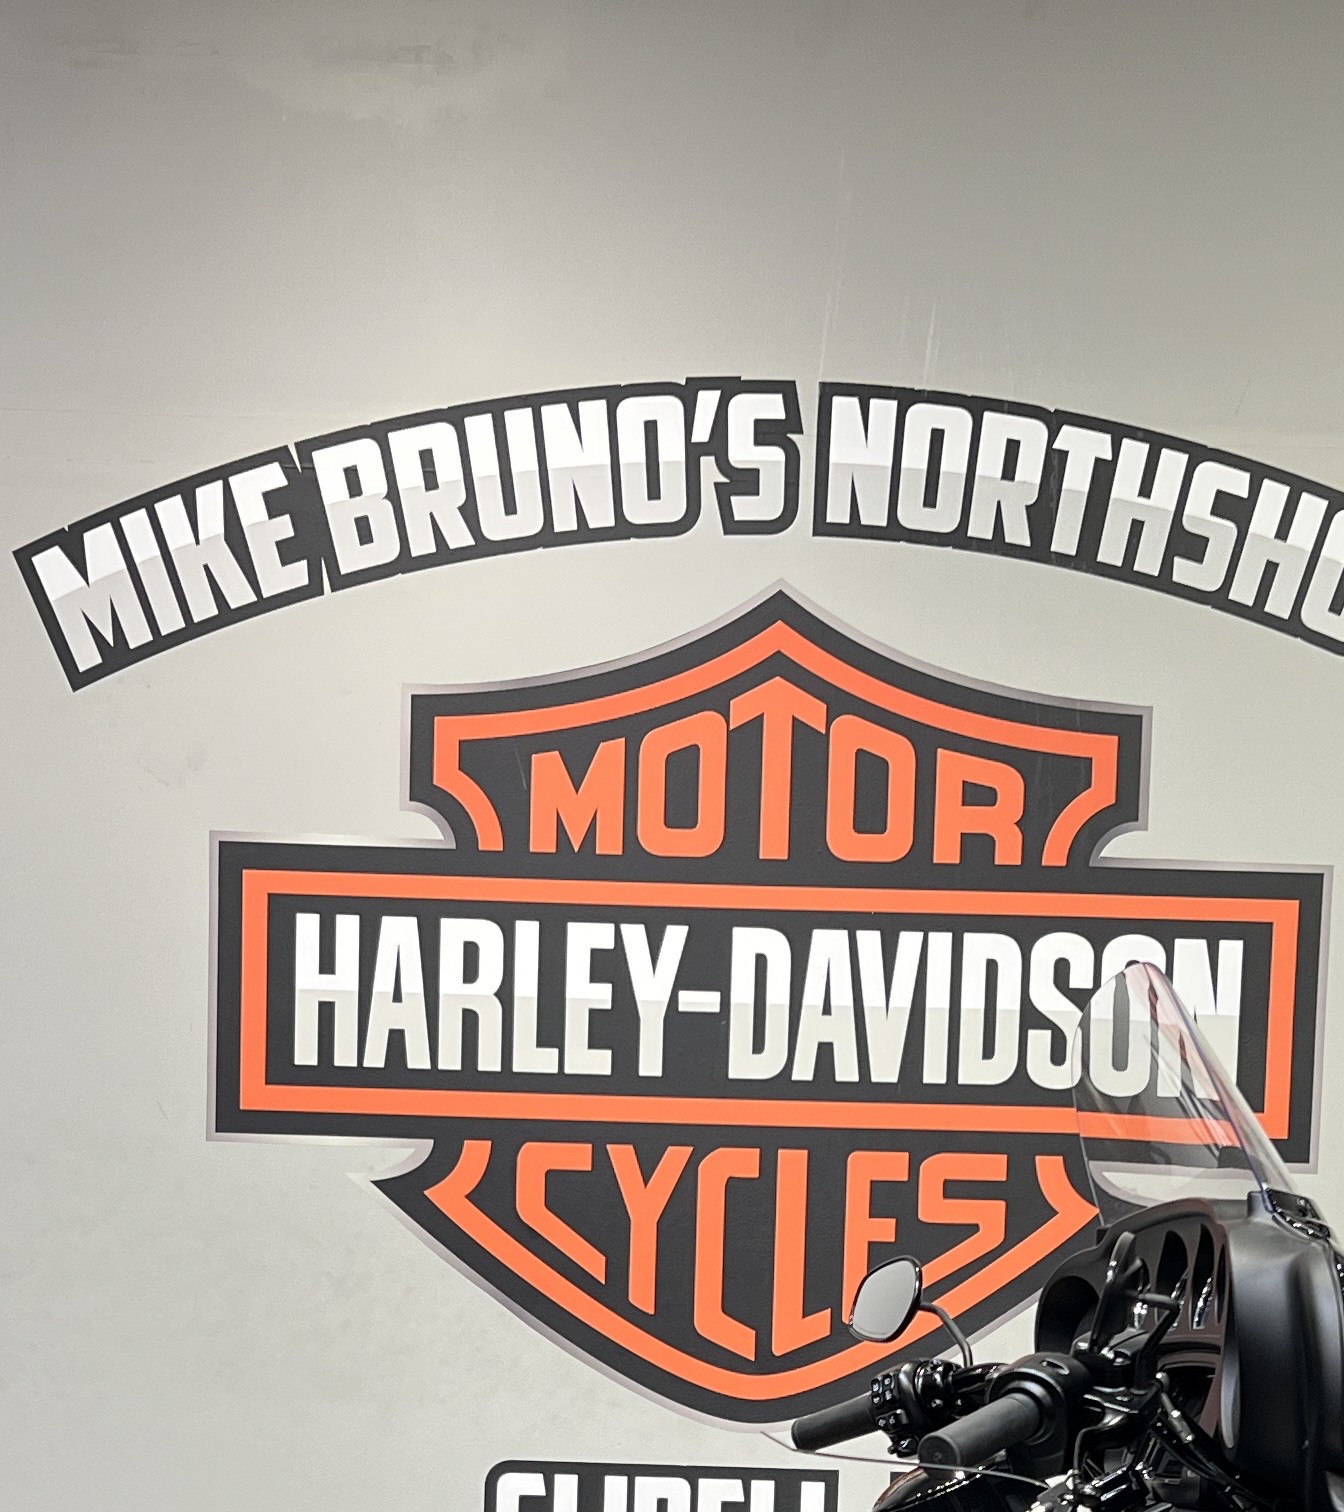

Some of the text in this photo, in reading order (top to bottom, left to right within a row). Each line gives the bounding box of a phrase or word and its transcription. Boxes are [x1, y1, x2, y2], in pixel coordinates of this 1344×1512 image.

[31, 460, 309, 674] MIKE
[311, 390, 788, 576] BRUNO'S
[529, 675, 1026, 867] MOTOR
[293, 912, 1244, 1099] HARLEY-DAVIDSON
[515, 1140, 1008, 1362] CYCLES
